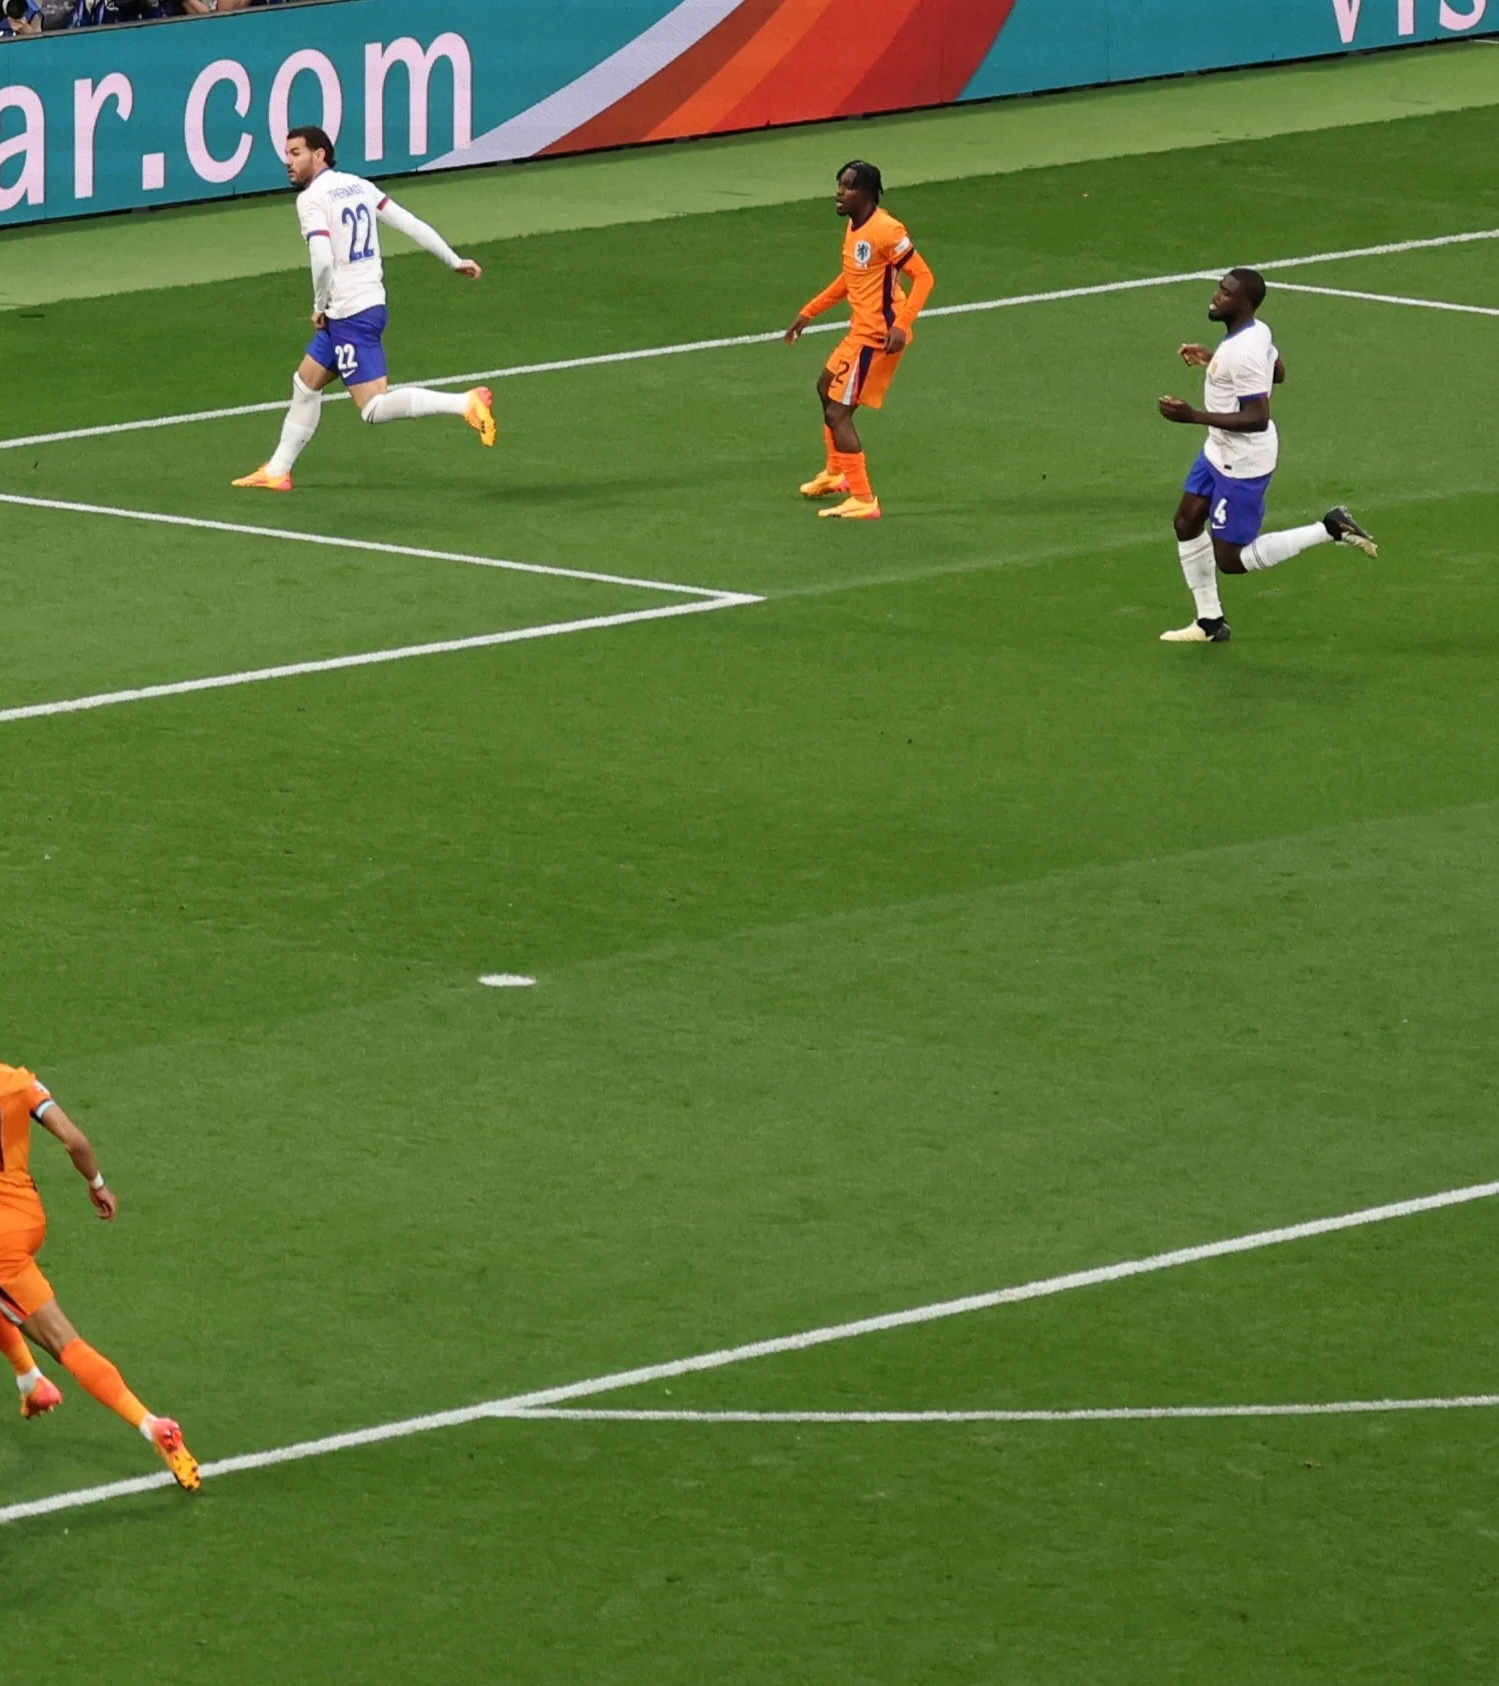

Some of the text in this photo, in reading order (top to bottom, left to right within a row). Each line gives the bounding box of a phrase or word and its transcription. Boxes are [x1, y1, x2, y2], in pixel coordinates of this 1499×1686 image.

[341, 203, 374, 263] 22
[334, 343, 358, 371] 22
[1214, 498, 1228, 524] 4
